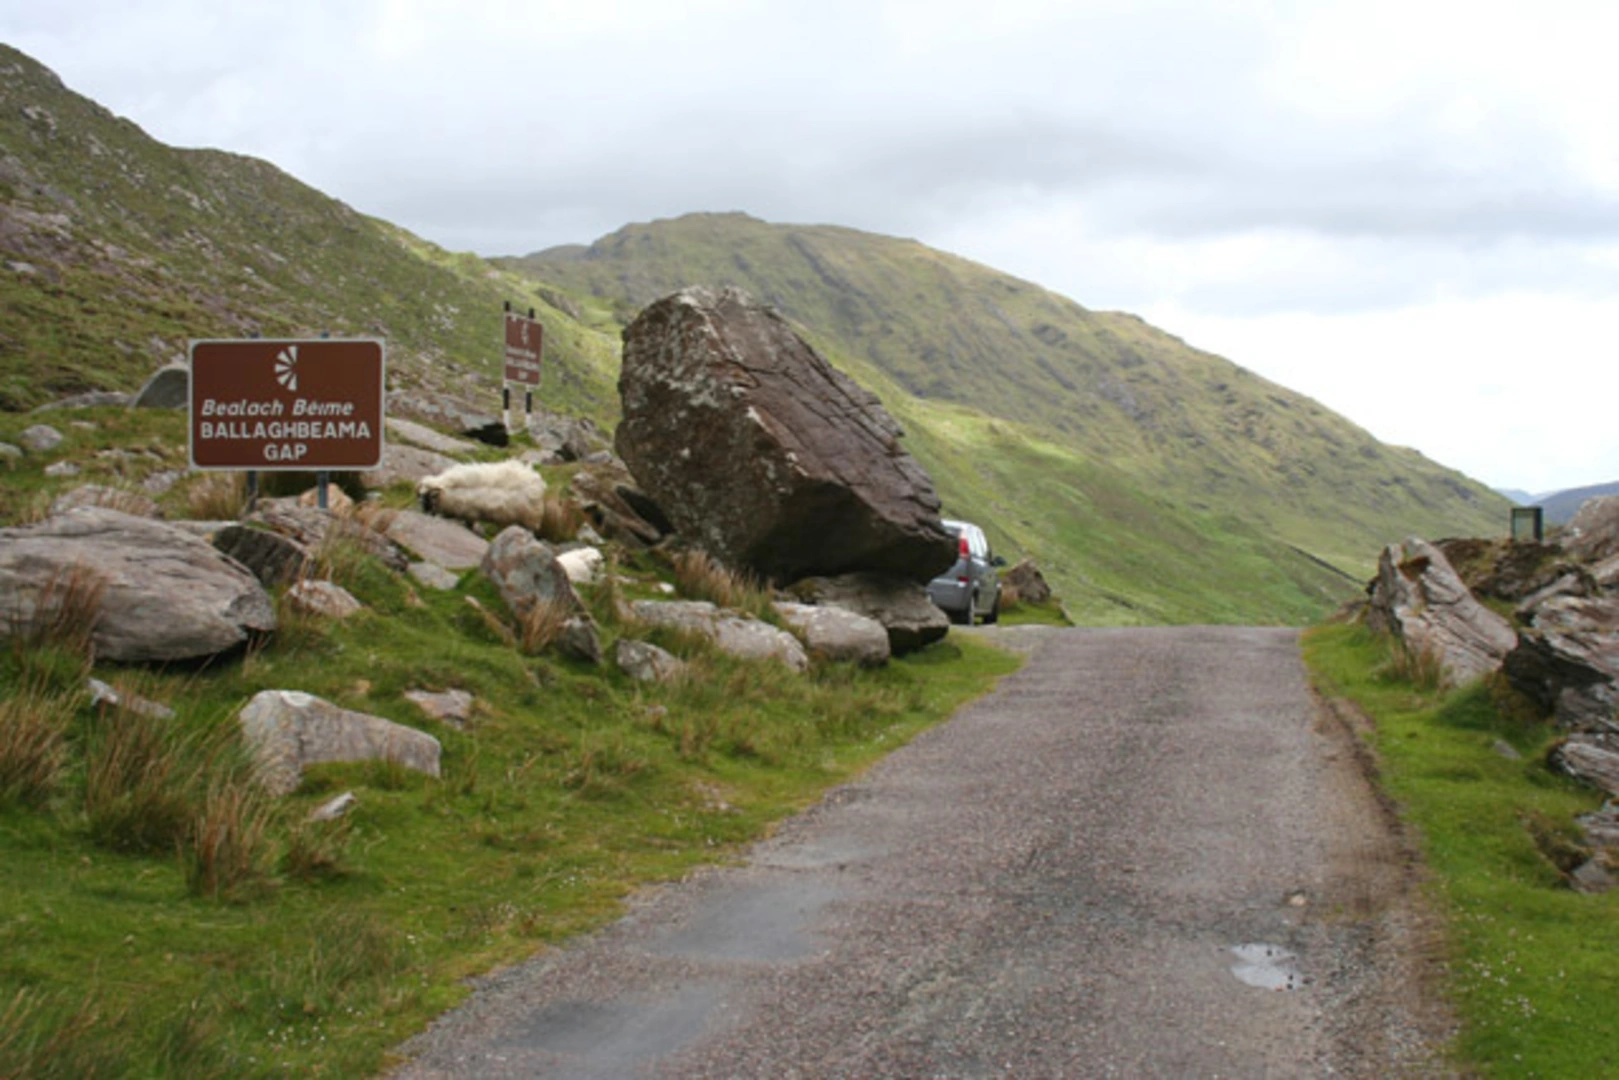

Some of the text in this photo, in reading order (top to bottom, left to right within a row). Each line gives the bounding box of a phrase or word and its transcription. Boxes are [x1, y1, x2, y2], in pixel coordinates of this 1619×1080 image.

[202, 399, 284, 416] Bealach
[200, 421, 371, 439] BALLAGHBEAMA
[263, 444, 307, 461] GAP
